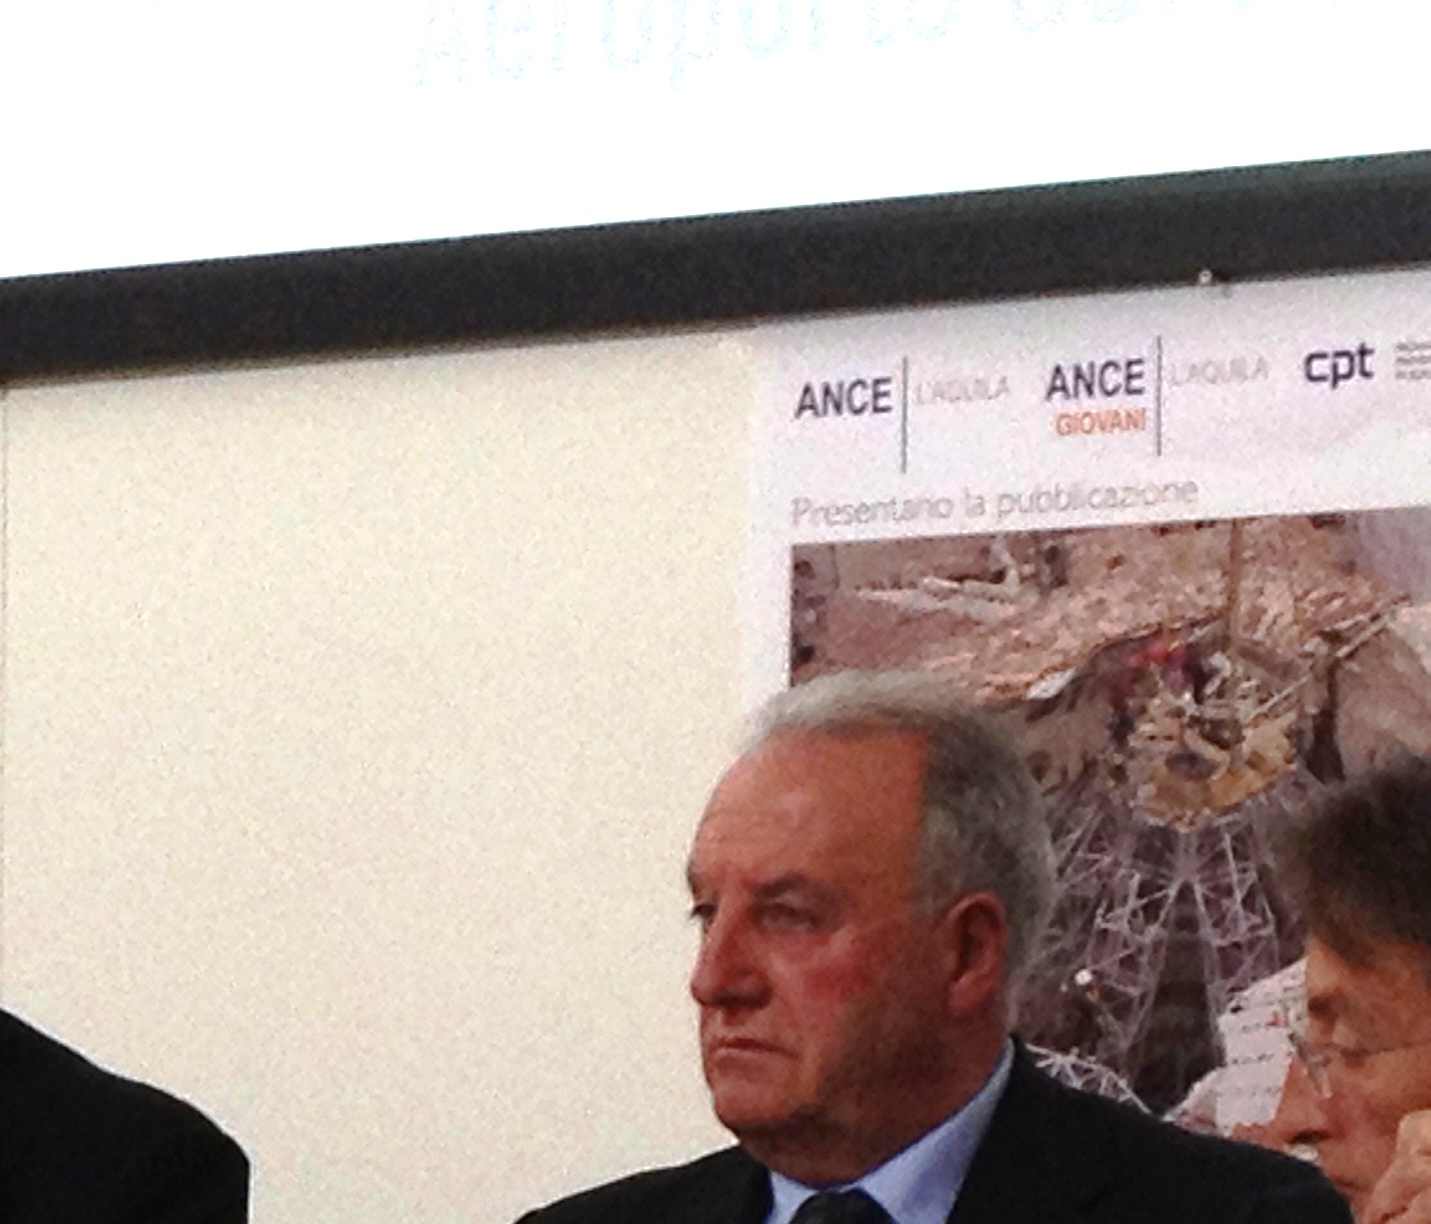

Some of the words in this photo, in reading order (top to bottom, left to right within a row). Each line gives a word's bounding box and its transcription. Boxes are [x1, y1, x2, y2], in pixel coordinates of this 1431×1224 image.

[1046, 358, 1146, 401] ANCE
[1304, 342, 1375, 390] cpt
[794, 376, 893, 418] ANCE
[1055, 407, 1147, 436] GIOVANI
[790, 496, 953, 527] Presentano
[964, 486, 986, 517] la
[996, 478, 1200, 520] pubblicazione
